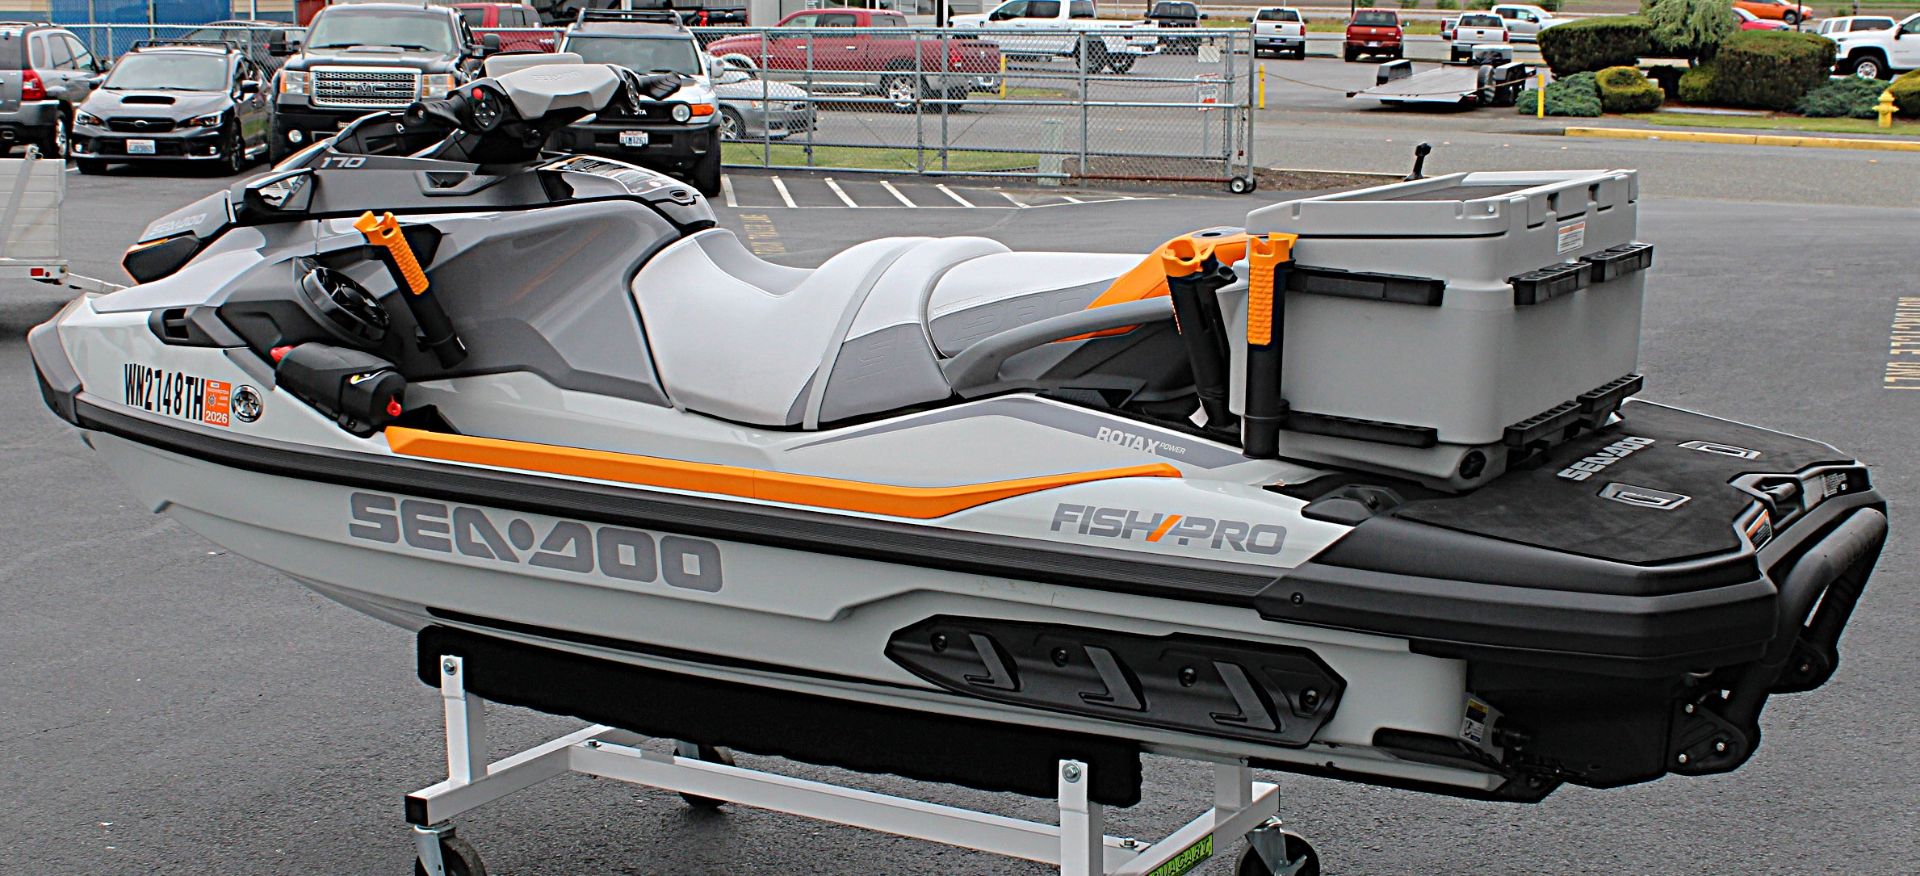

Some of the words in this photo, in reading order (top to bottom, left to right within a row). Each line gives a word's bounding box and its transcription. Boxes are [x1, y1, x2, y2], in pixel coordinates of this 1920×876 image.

[342, 83, 388, 94] GMC
[320, 157, 367, 169] 170
[124, 362, 205, 422] WN2748TH
[205, 410, 228, 424] 2026
[1096, 426, 1160, 456] ROTAX
[1160, 442, 1187, 455] POWER
